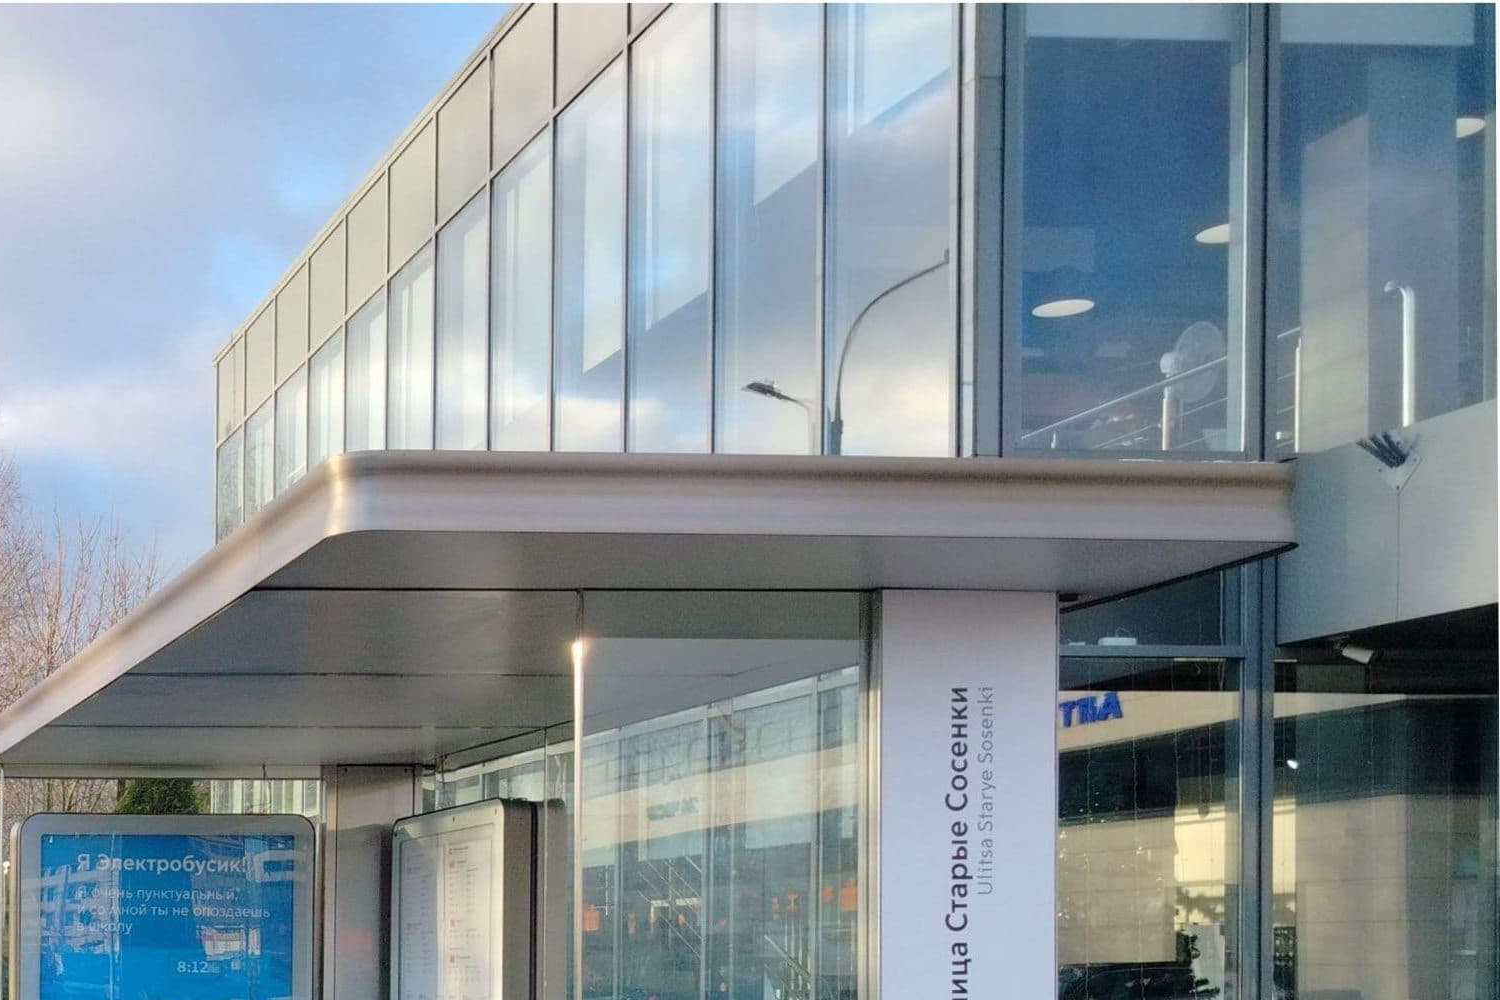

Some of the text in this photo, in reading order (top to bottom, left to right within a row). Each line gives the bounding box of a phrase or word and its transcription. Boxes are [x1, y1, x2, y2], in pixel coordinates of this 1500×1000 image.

[945, 687, 969, 811] Сосенки
[977, 686, 996, 895] Ulitsa Starye Sosenki
[77, 853, 247, 875] Я Электробусик!
[945, 821, 973, 932] Старые
[89, 922, 133, 935] школу
[151, 906, 169, 916] ты
[172, 907, 189, 916] не
[193, 907, 271, 919] опоздаешь
